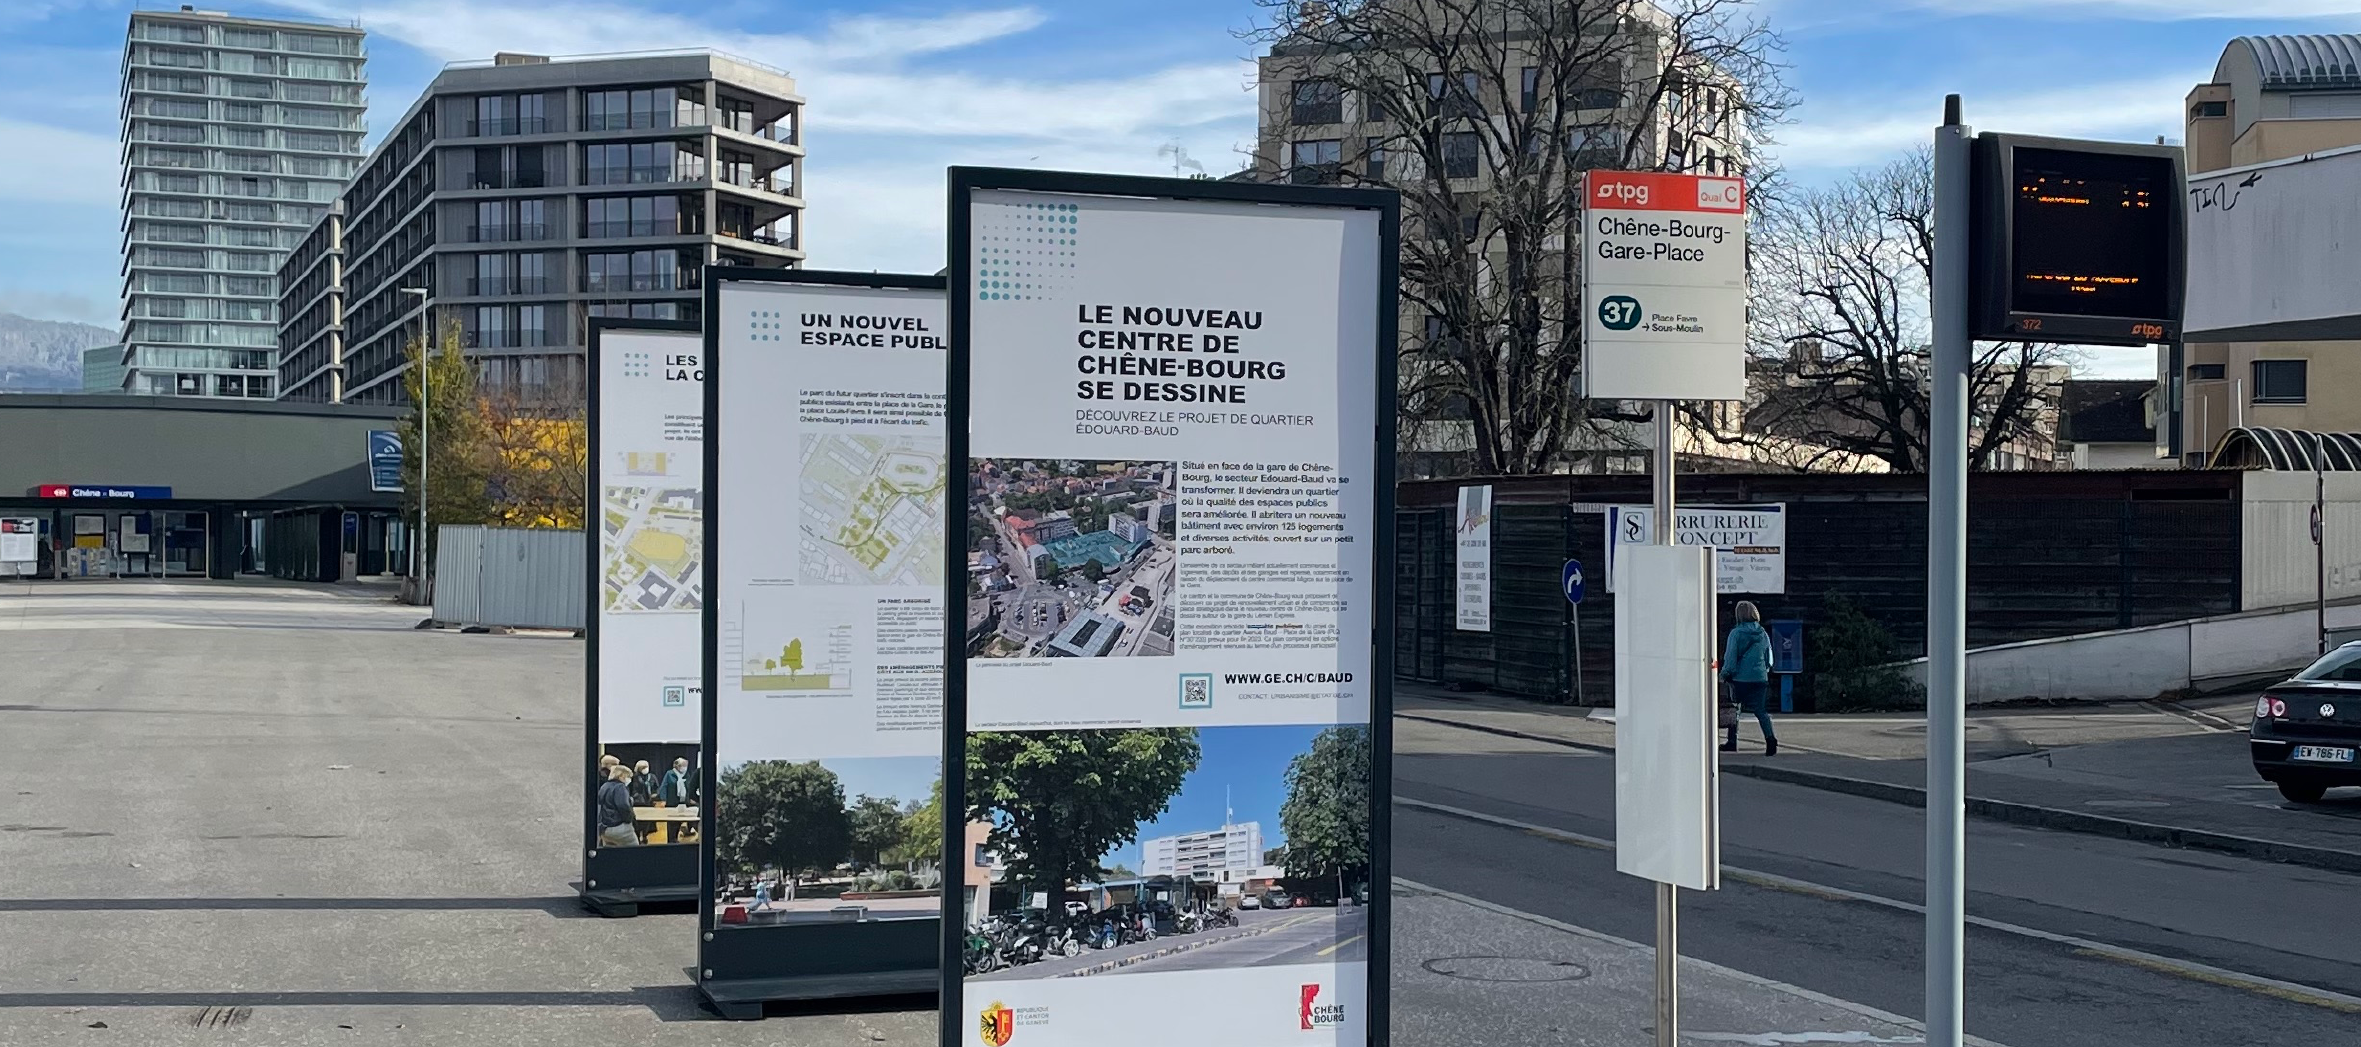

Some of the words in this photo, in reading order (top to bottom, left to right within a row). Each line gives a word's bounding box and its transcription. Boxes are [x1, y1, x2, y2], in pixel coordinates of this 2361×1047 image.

[1616, 181, 1648, 205] tpg
[1701, 192, 1721, 202] Quai
[1725, 186, 1737, 202] C
[1599, 217, 1731, 243] Chêne-Bourg-
[1599, 241, 1704, 261] Gare-Place
[1079, 304, 1113, 324] LE
[1123, 306, 1262, 330] NOUVEAU
[1604, 301, 1636, 323] 37
[1652, 313, 1674, 322] Place
[801, 313, 832, 327] UN
[840, 315, 929, 332] NOUVEL
[2022, 319, 2042, 330] 372
[801, 332, 884, 348] ESPACE
[891, 334, 947, 350] PUBL
[1078, 330, 1193, 352] CENTRE
[1203, 334, 1239, 354] DE
[666, 355, 697, 366] LES
[1078, 351, 1286, 380] CHÊNE-BOURG
[666, 369, 688, 380] LA
[694, 370, 703, 381] C
[1077, 380, 1114, 400] SE
[1124, 381, 1246, 404] DESSINE
[1076, 409, 1156, 422] DÉCOUVREZ
[1160, 411, 1174, 422] LE
[1178, 412, 1227, 424] PROJET
[1231, 413, 1247, 424] DE
[1250, 414, 1314, 426] QUARTIER
[1076, 422, 1179, 436] ÉDOUARD-BAUD
[1182, 461, 1205, 471] Situé
[1208, 463, 1219, 471] en
[1222, 462, 1240, 470] face
[1243, 462, 1253, 472] de
[1256, 462, 1264, 471] la
[1267, 464, 1286, 472] gare
[1289, 463, 1299, 471] de
[1302, 463, 1333, 473] Chêne-
[1215, 474, 1223, 484] le
[1225, 474, 1258, 484] secteur
[1327, 477, 1336, 485] va
[1339, 475, 1349, 484] se
[72, 489, 100, 497] Chêne
[109, 489, 134, 498] Bourg
[1239, 486, 1244, 496] Il
[1246, 487, 1289, 496] deviendra
[1292, 487, 1303, 495] un
[1306, 487, 1339, 497] quartier
[1182, 497, 1193, 507] où
[1197, 497, 1203, 506] la
[1206, 497, 1236, 508] qualité
[1239, 498, 1254, 508] des
[1257, 498, 1293, 508] espaces
[1296, 498, 1328, 509] publics
[1252, 510, 1256, 519] Il
[1259, 510, 1292, 519] abritera
[1295, 510, 1306, 519] un
[1309, 510, 1346, 520] nouveau
[1181, 521, 1221, 530] bâtiment
[1224, 522, 1244, 532] avec
[1246, 522, 1278, 532] environ
[1282, 522, 1296, 532] 125
[1298, 522, 1343, 533] logements
[1676, 515, 1768, 529] RRURERIE
[1181, 534, 1190, 543] et
[1193, 534, 1229, 543] diverses
[1335, 535, 1353, 544] petit
[1181, 546, 1201, 556] parc
[1224, 673, 1353, 684] WWW.GE.CH/C/BAUD
[1315, 1014, 1344, 1023] BOURG
